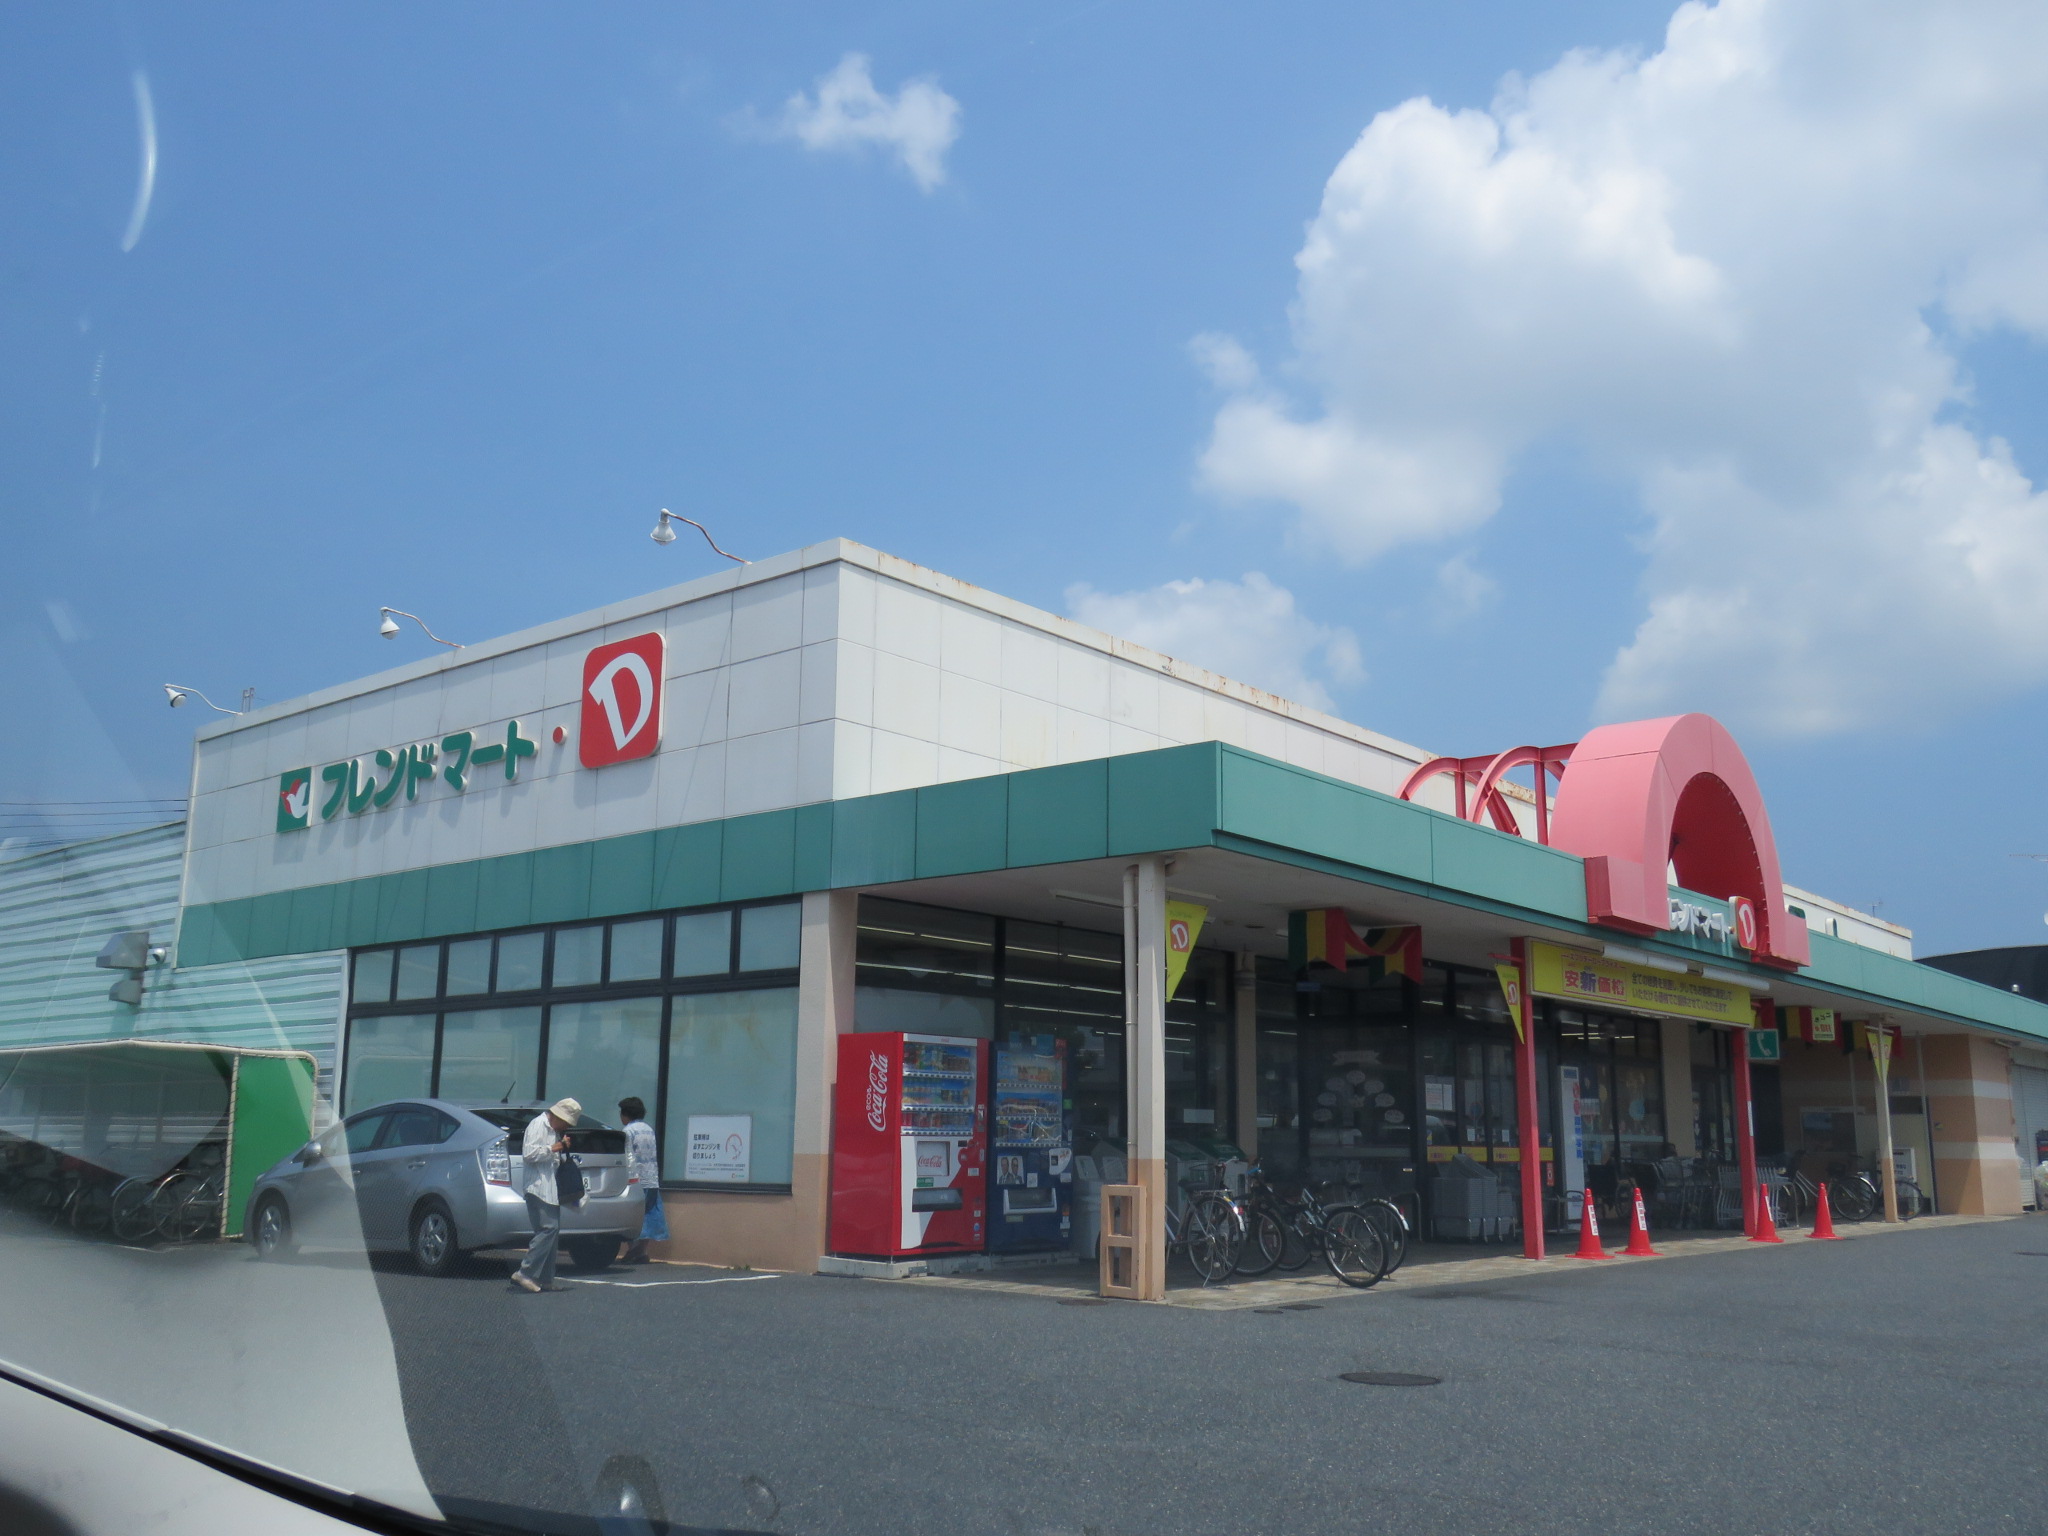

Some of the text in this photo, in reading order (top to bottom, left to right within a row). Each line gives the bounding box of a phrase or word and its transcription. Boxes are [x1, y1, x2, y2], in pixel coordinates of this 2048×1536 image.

[322, 720, 536, 820] フレンドマート
[868, 1050, 889, 1132] Coca-Cola
